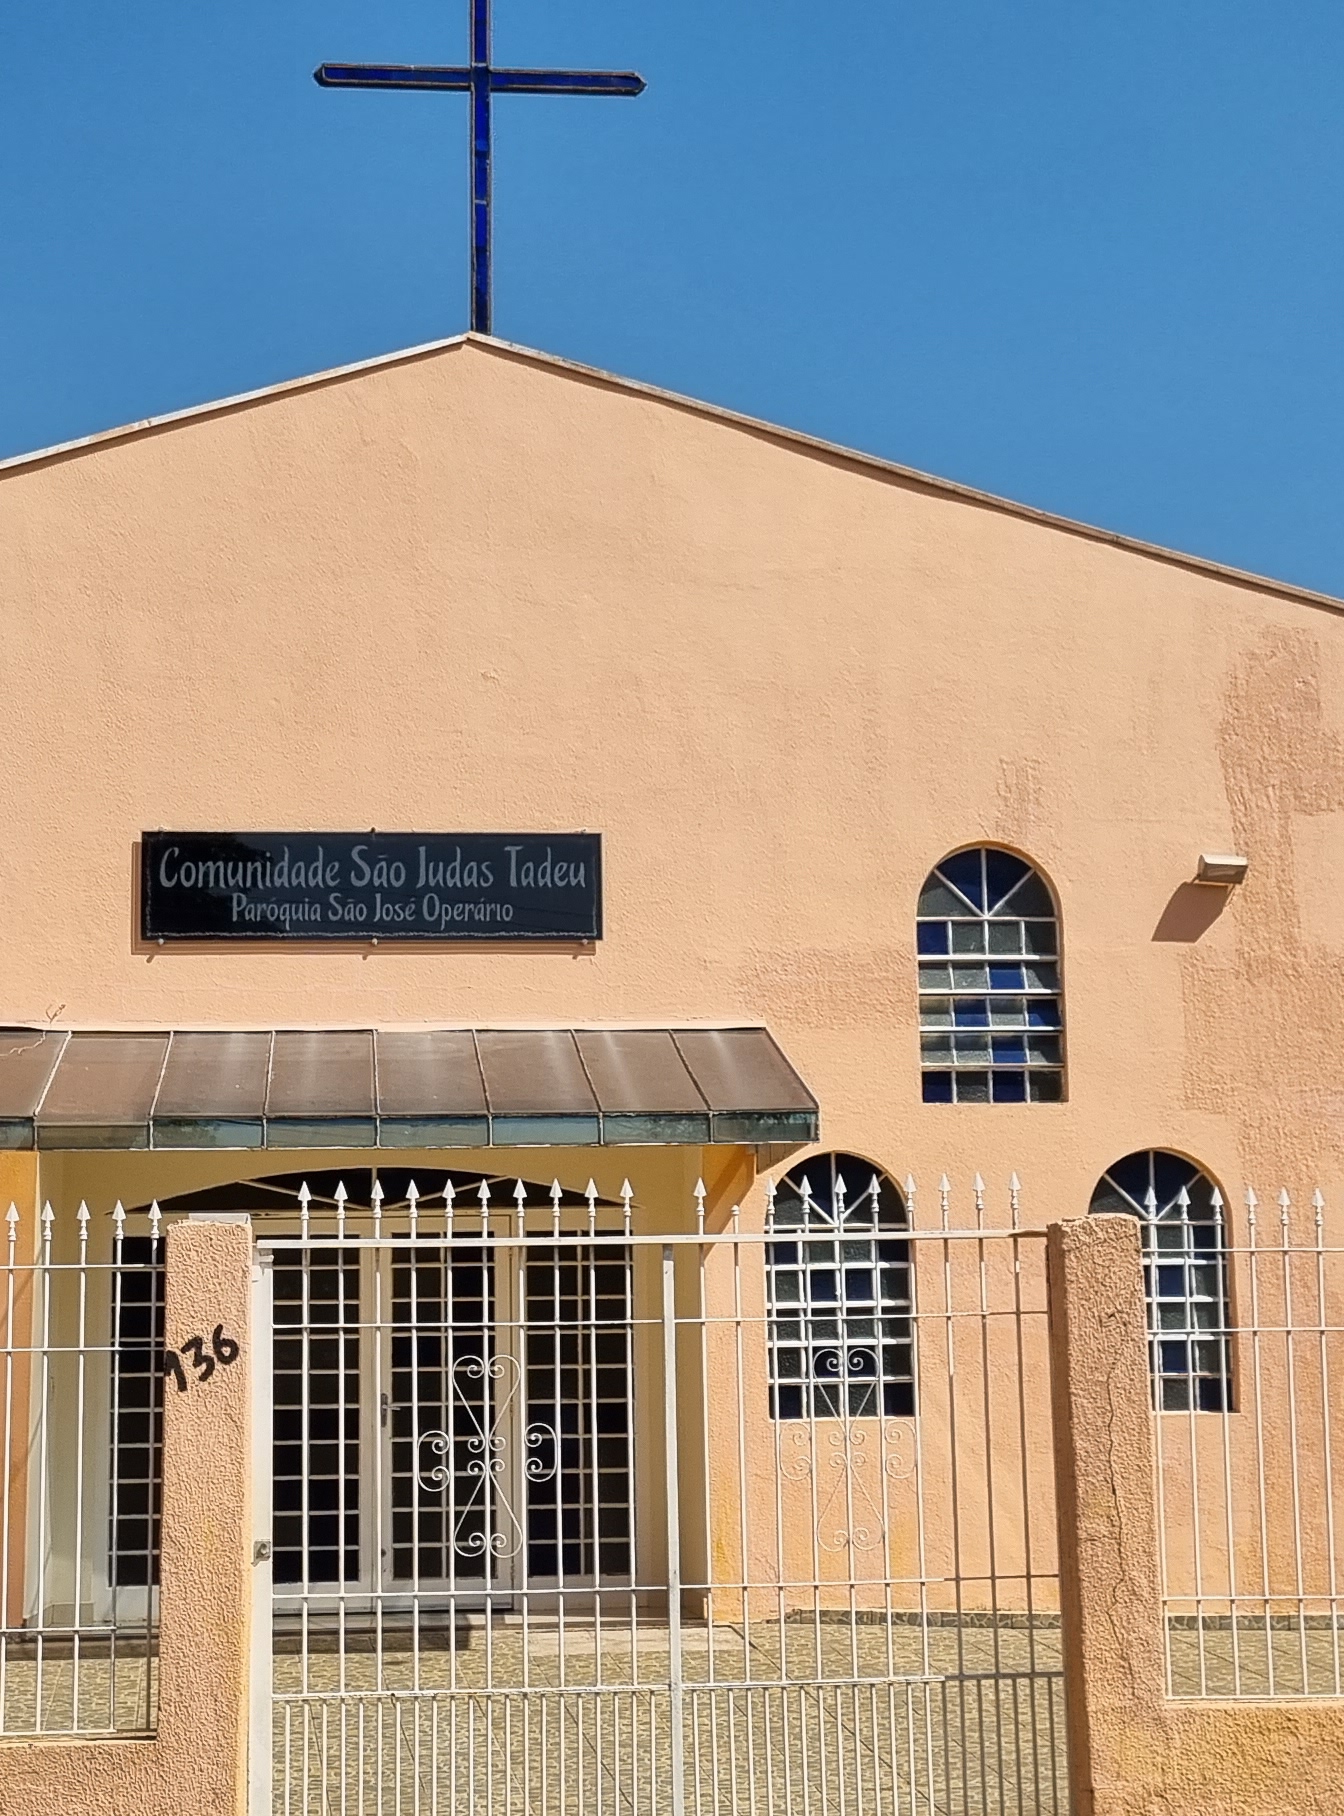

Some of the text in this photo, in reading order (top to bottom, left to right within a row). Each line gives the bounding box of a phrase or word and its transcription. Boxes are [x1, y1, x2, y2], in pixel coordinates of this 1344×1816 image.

[159, 845, 586, 889] Comunidade São Judas Tadeu
[232, 892, 514, 931] Paróquia São José Operário
[164, 1323, 240, 1393] 136
